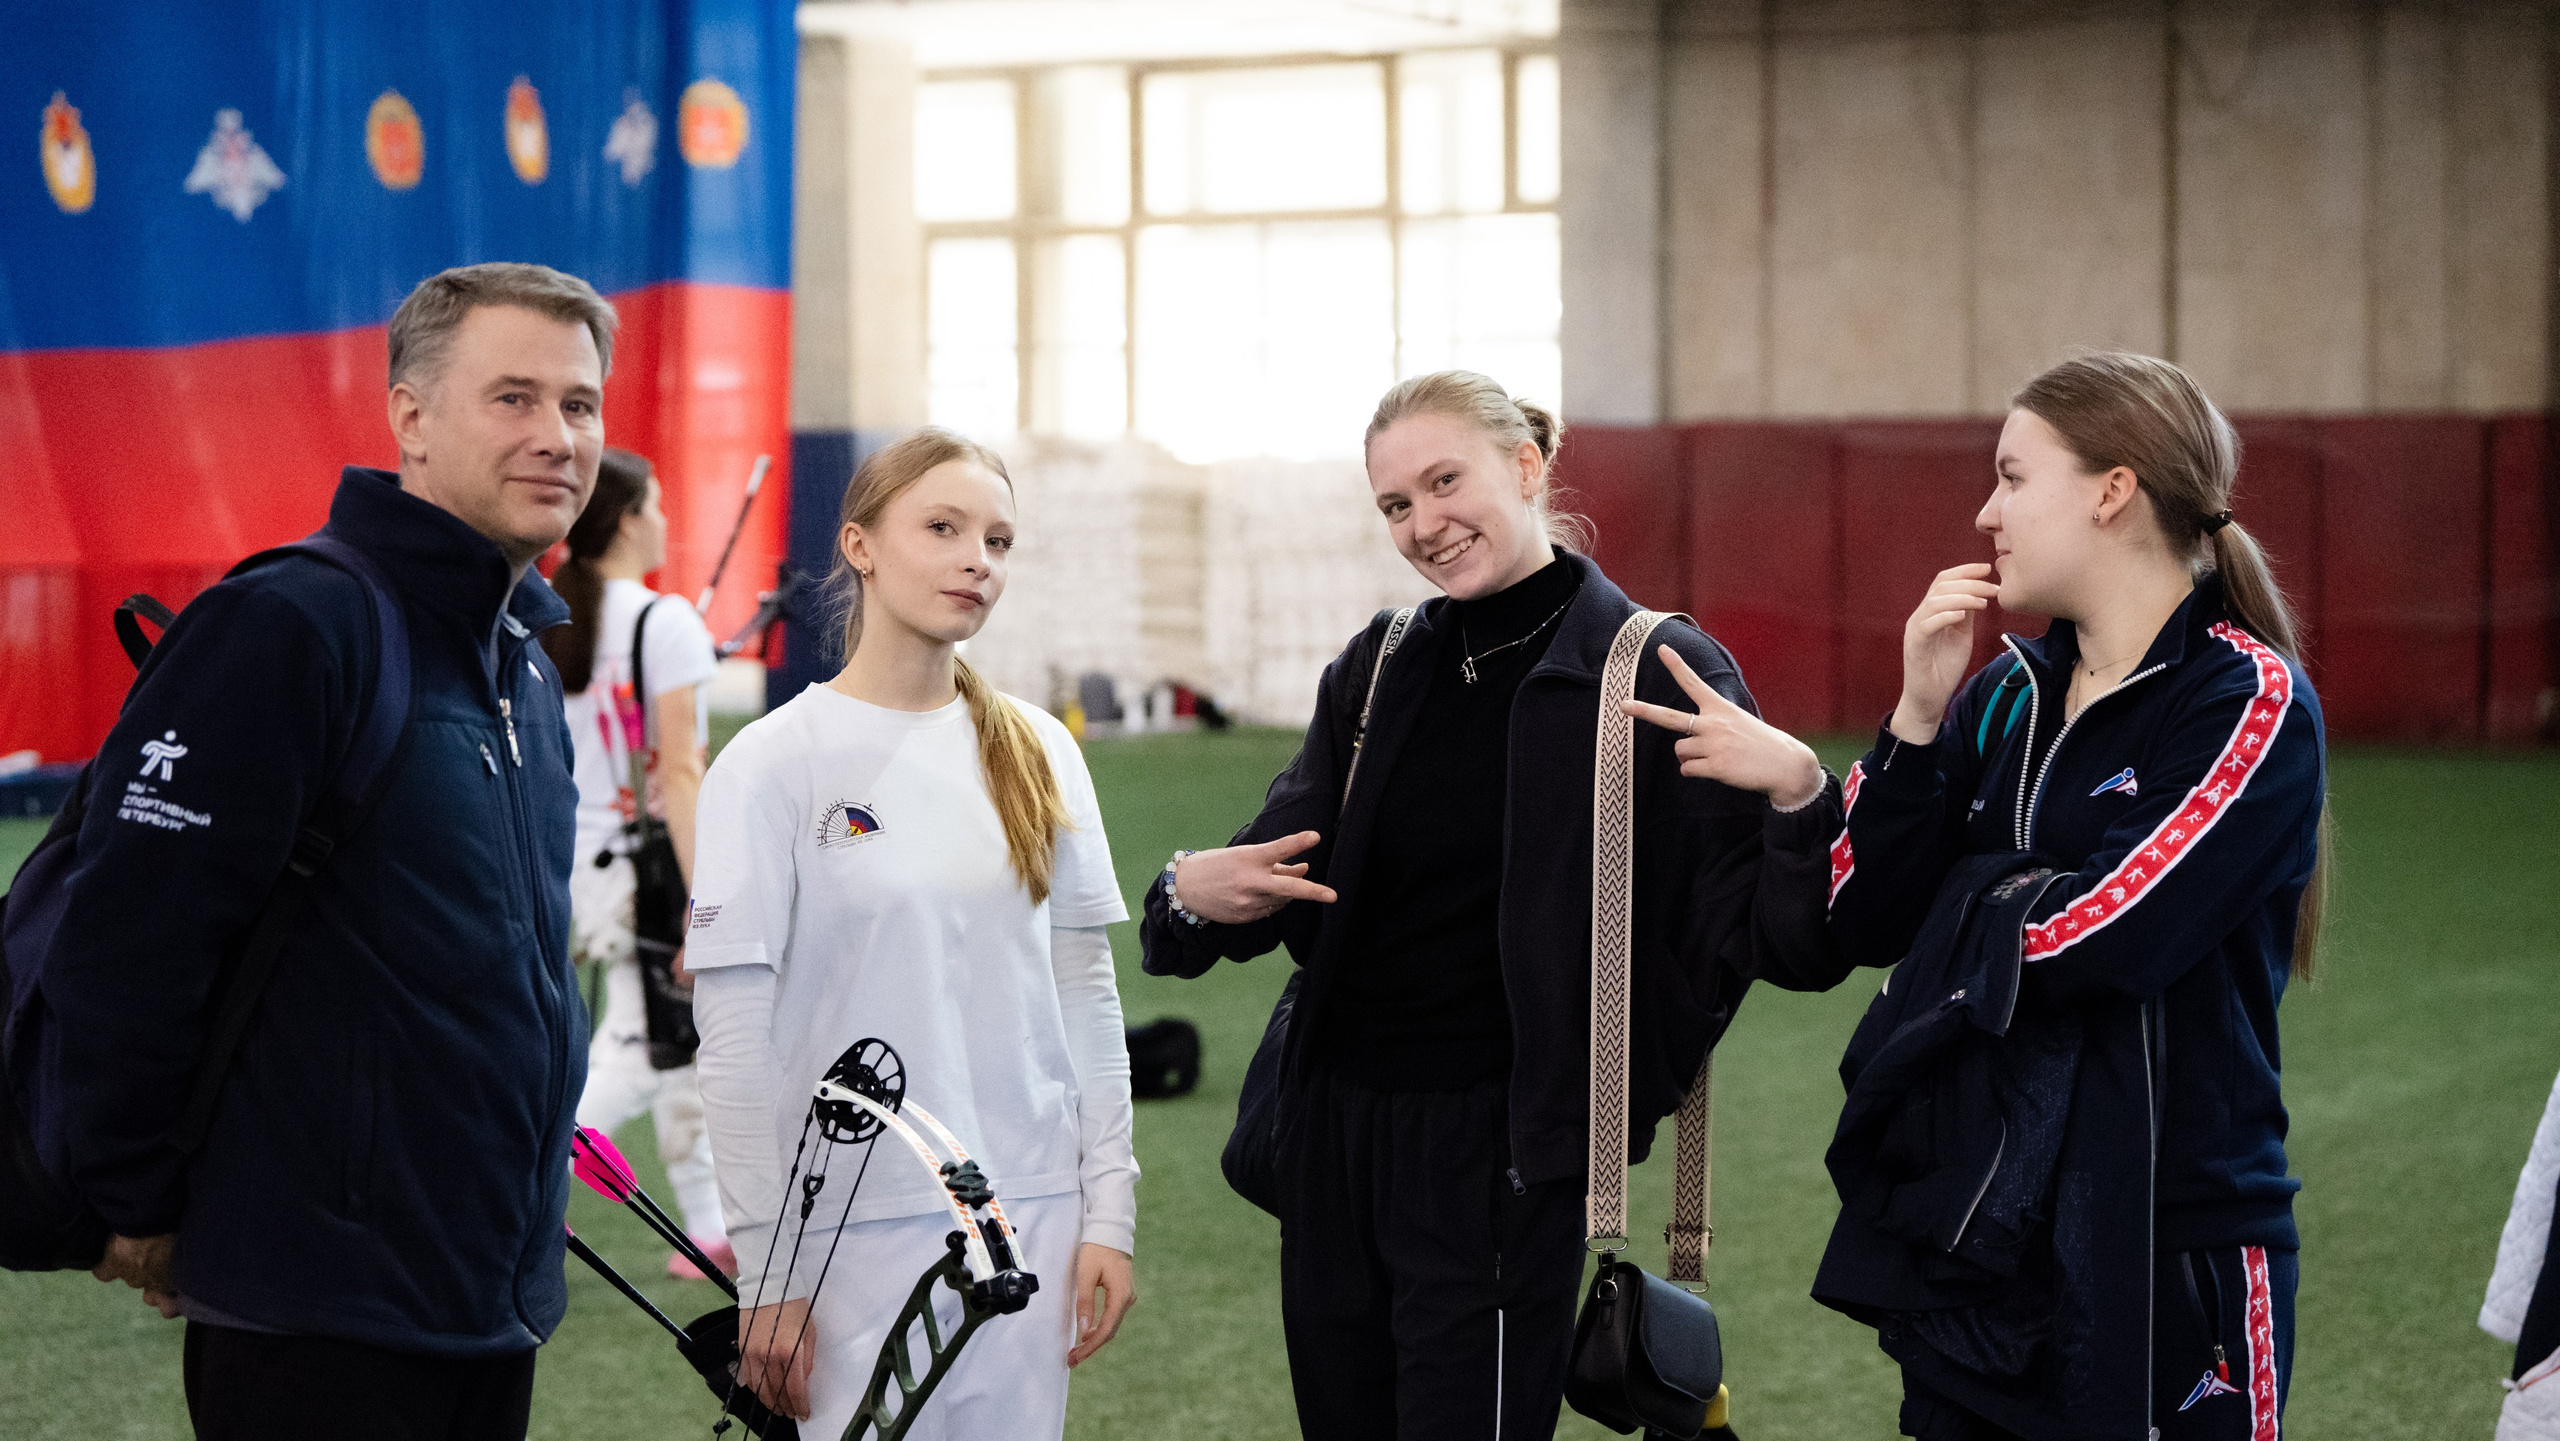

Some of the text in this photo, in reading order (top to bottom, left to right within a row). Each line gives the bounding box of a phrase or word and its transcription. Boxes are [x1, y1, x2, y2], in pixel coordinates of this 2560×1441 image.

[1384, 624, 1402, 656] ASSN.
[127, 781, 146, 794] МЫ
[116, 807, 187, 832] ПЕТЕРБУРГ
[122, 795, 212, 827] СПОРТИВНЫЙ
